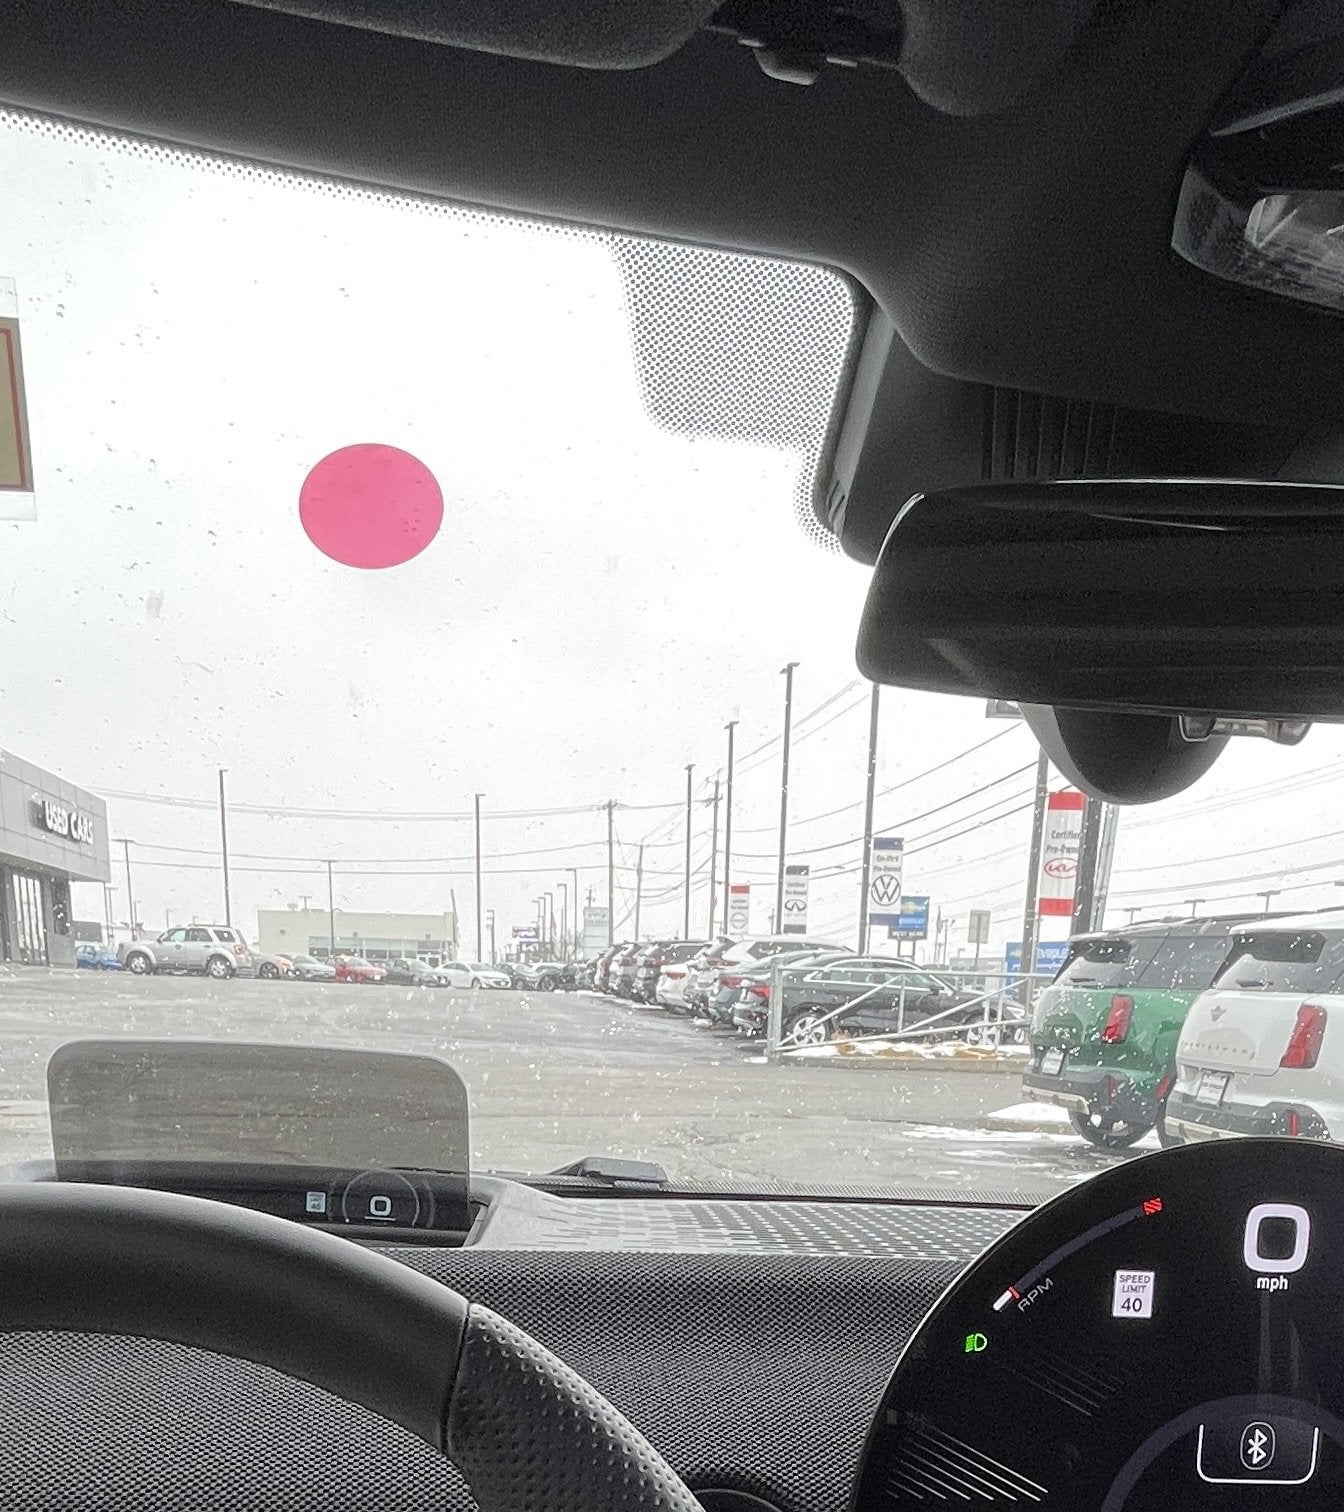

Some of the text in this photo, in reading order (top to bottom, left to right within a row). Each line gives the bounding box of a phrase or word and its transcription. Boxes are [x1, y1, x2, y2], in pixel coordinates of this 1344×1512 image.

[45, 800, 94, 845] USED CARS
[1243, 1203, 1311, 1273] 0
[1118, 1274, 1151, 1285] SPEED
[1256, 1275, 1289, 1293] mph
[1017, 1277, 1054, 1313] RPM
[1121, 1284, 1147, 1295] LIMIT
[1120, 1297, 1144, 1313] 40
